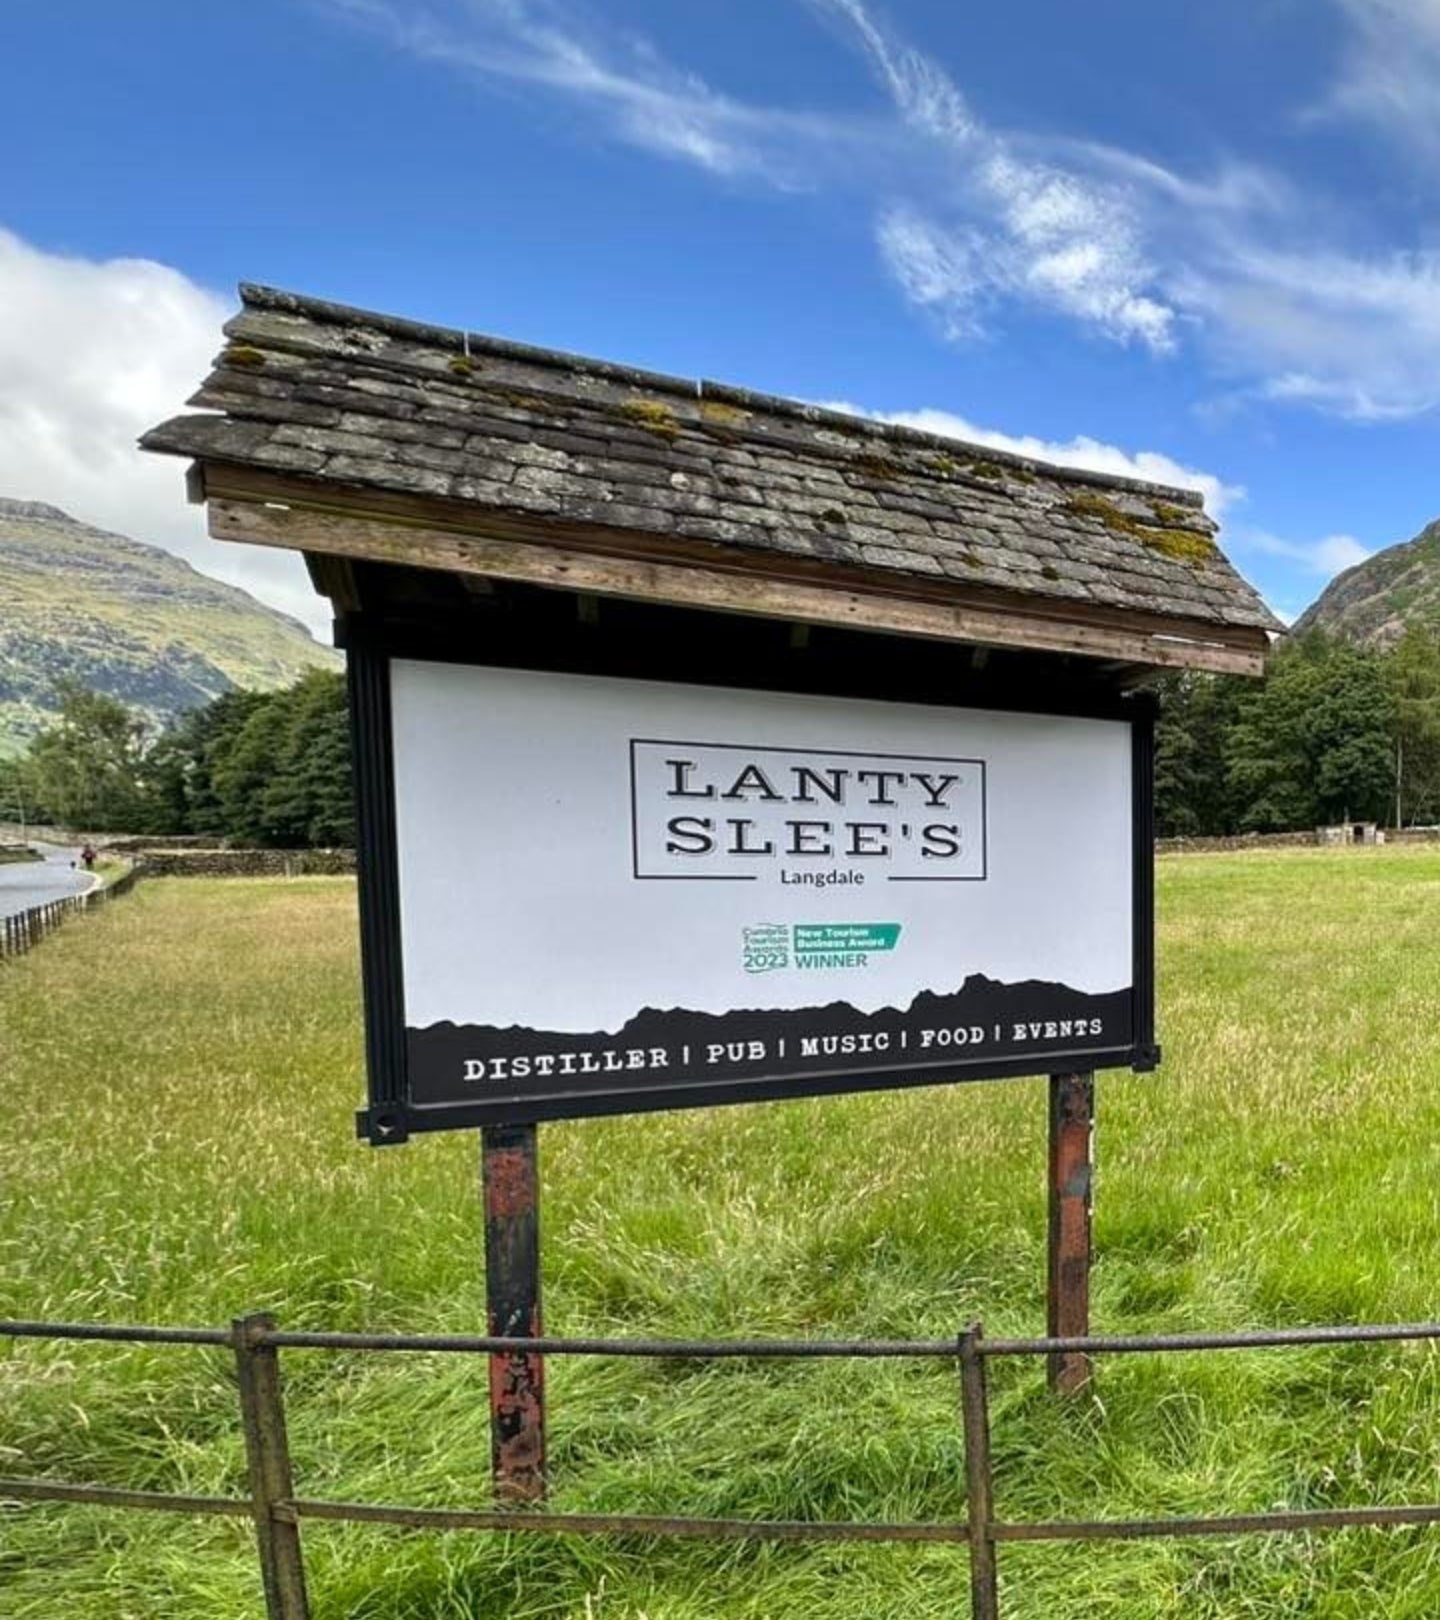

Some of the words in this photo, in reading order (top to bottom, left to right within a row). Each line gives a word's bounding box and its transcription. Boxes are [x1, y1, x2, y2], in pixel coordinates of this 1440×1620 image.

[666, 759, 961, 808] LANTY
[666, 816, 961, 860] SLEE'S
[780, 868, 865, 888] Langdale
[743, 928, 788, 936] Cumbria
[797, 929, 823, 937] New
[826, 928, 869, 937] Tourism
[743, 936, 788, 944] Tourism
[797, 939, 845, 948] Business
[848, 938, 885, 947] Award
[743, 945, 788, 953] Awards
[743, 953, 788, 968] 2023
[796, 953, 867, 968] WINNER
[463, 1047, 669, 1082] DISTILLER
[706, 1041, 767, 1065] PUB
[800, 1032, 890, 1057] MUSIC
[920, 1026, 985, 1049] FOOD
[1012, 1018, 1104, 1042] EVENTS
